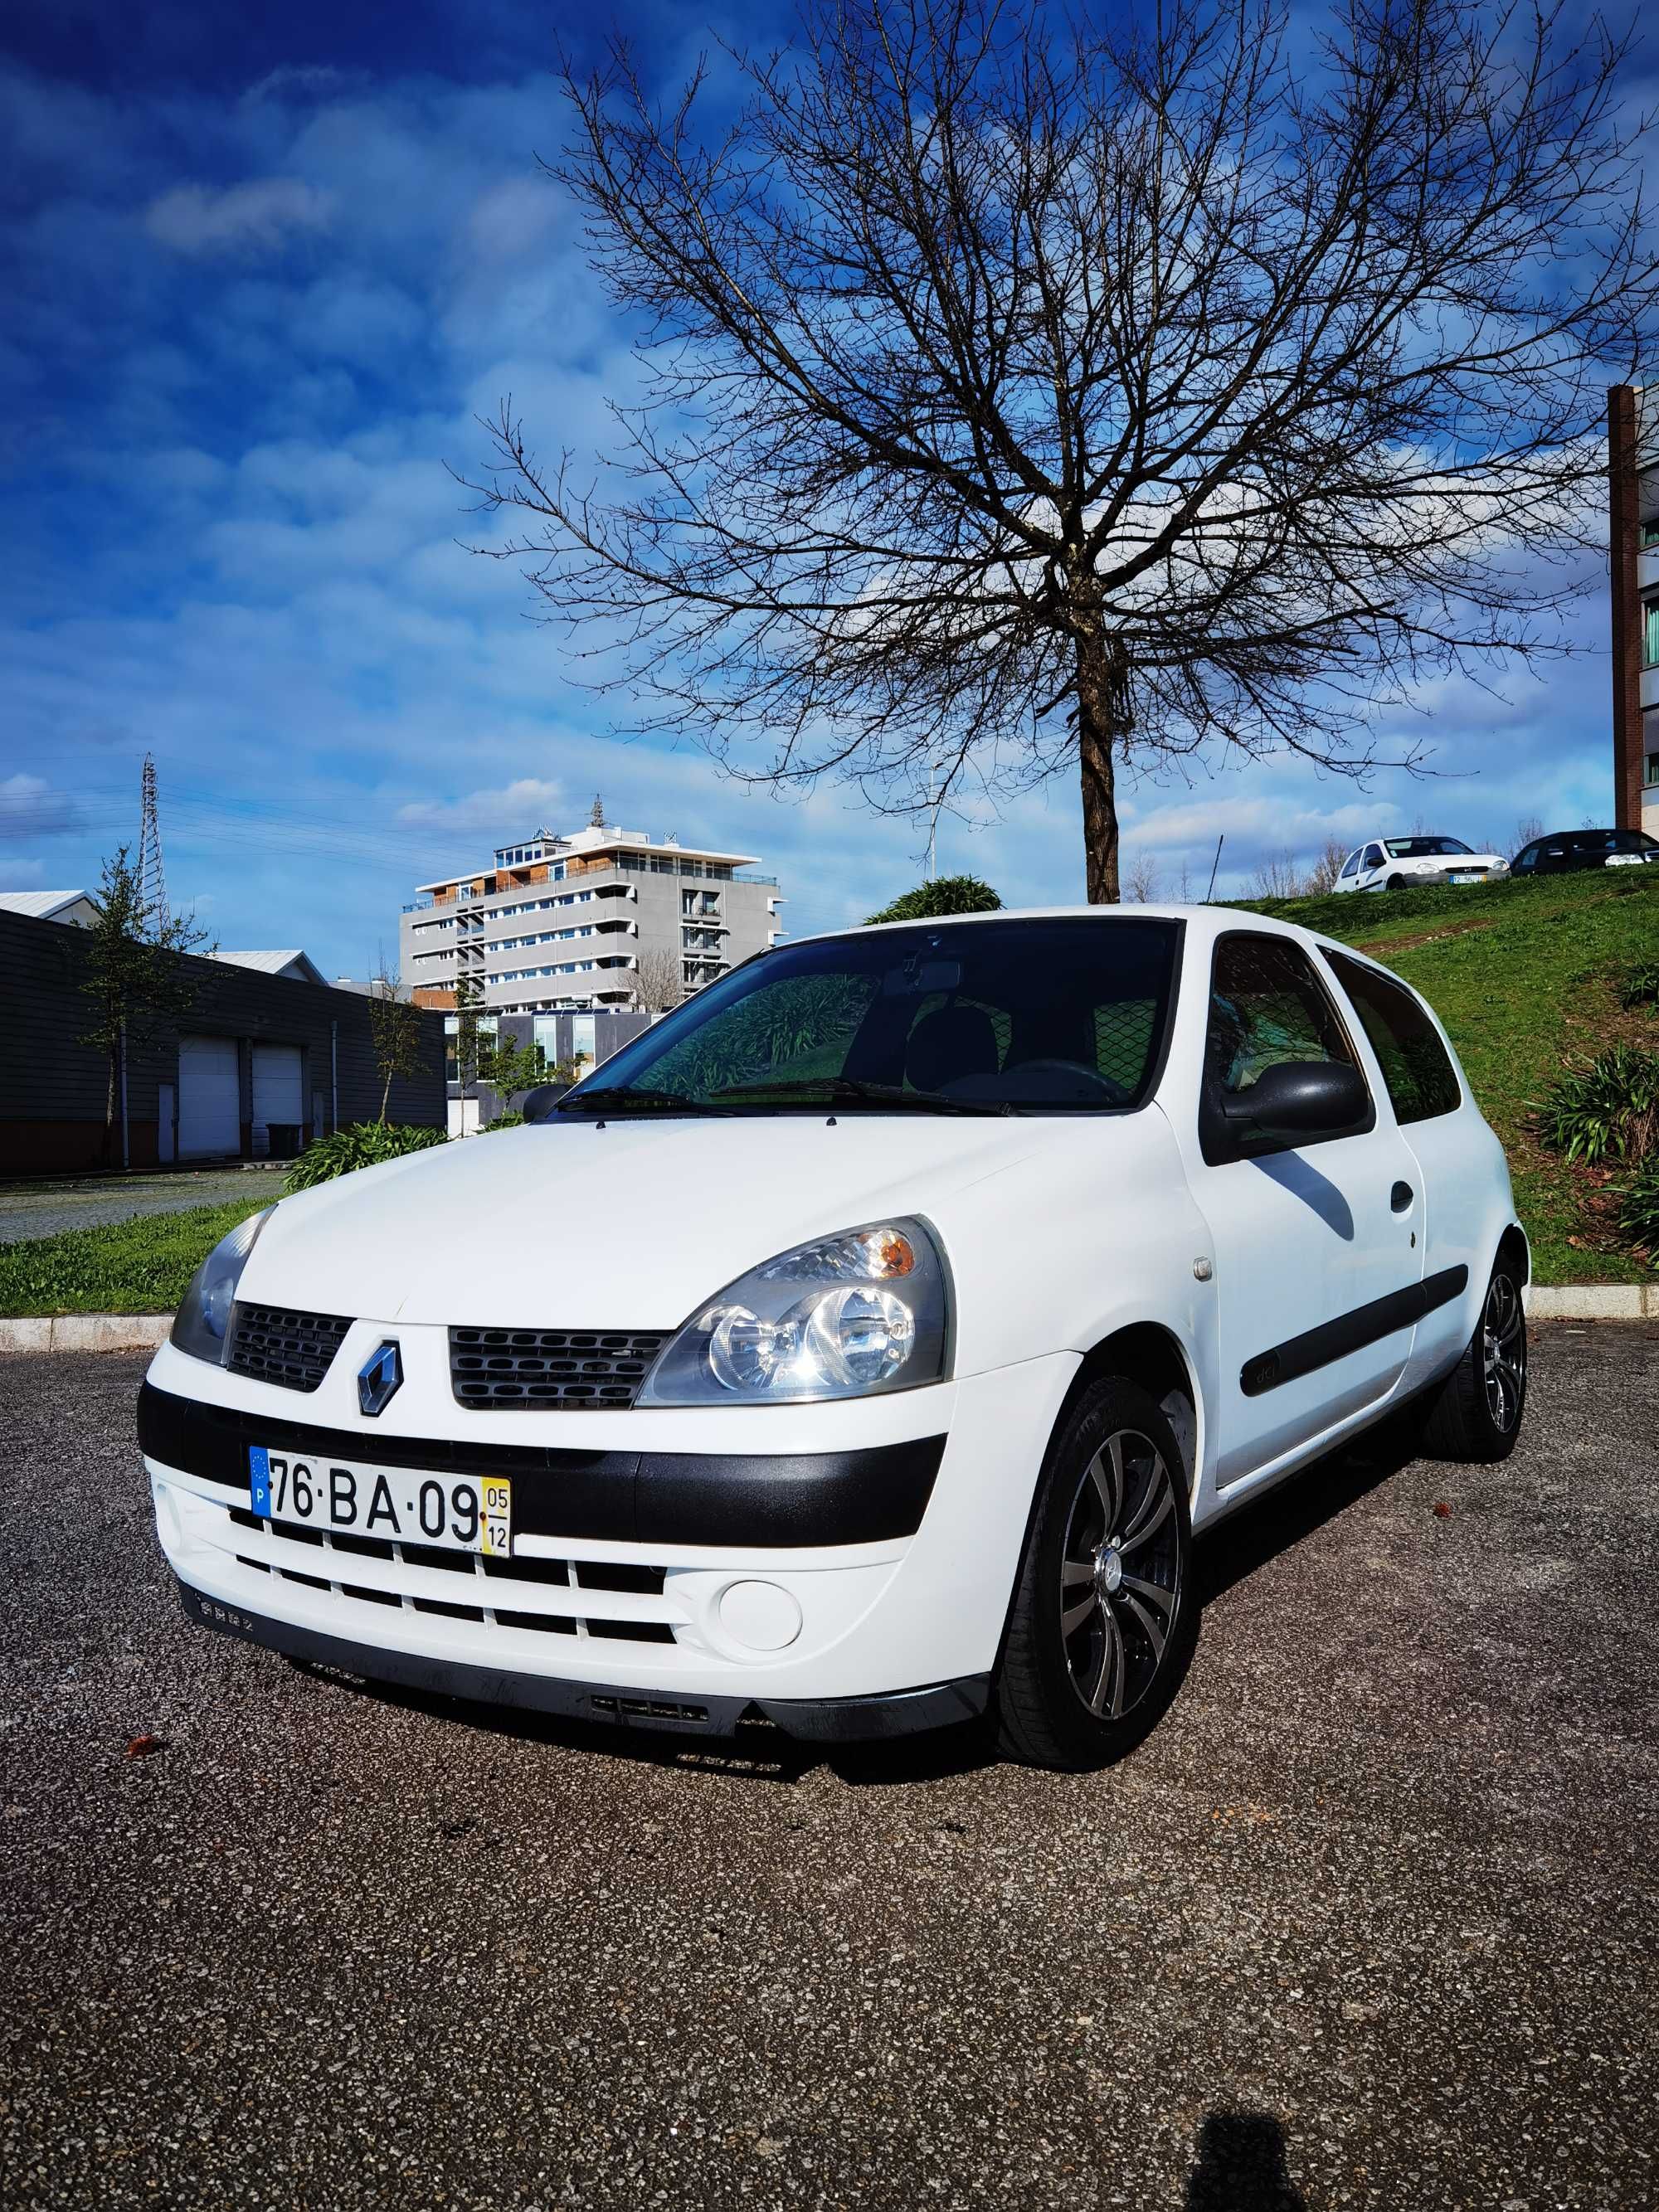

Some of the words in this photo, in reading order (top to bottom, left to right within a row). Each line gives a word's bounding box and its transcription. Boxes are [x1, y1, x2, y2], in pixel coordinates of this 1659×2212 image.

[256, 1488, 265, 1504] P
[487, 1487, 508, 1509] 05
[488, 1526, 506, 1548] 12
